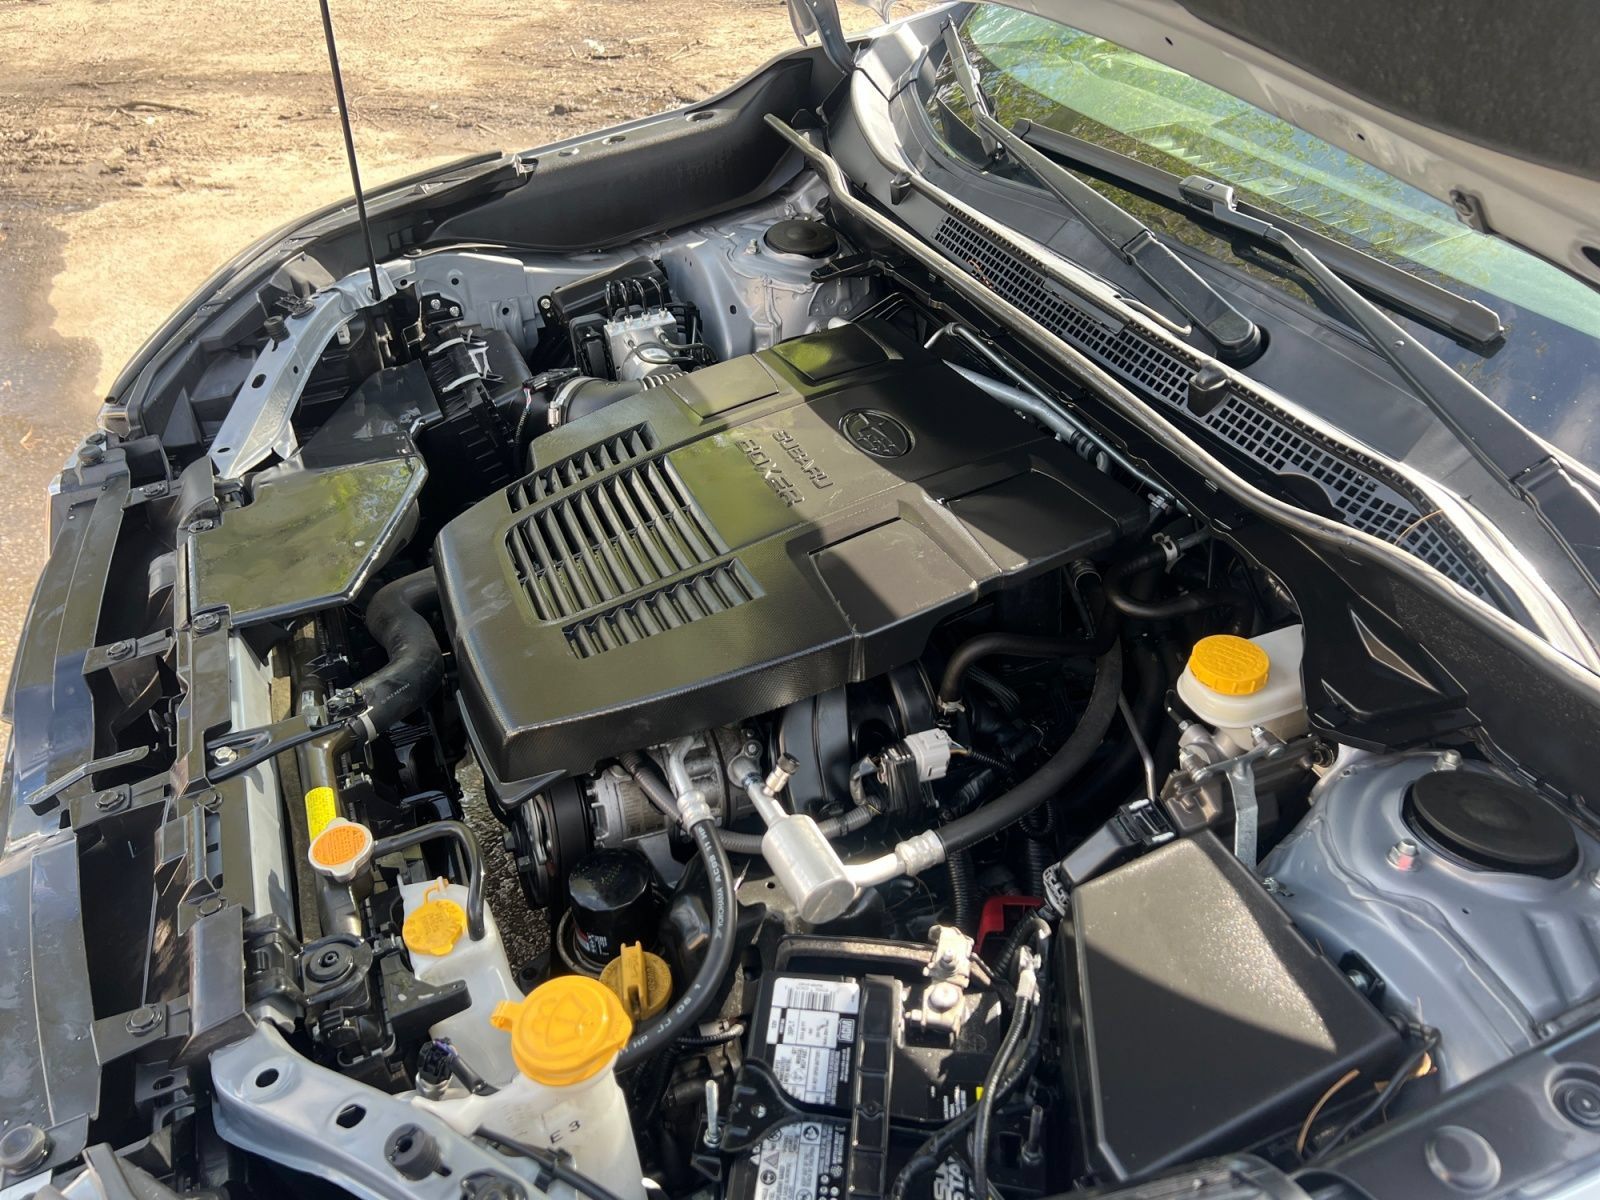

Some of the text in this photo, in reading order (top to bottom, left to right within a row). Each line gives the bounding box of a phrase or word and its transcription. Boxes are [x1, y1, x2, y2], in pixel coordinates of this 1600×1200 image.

[735, 438, 806, 508] BOXER
[772, 429, 834, 490] SUBARU
[717, 886, 725, 927] YOKOHAMA
